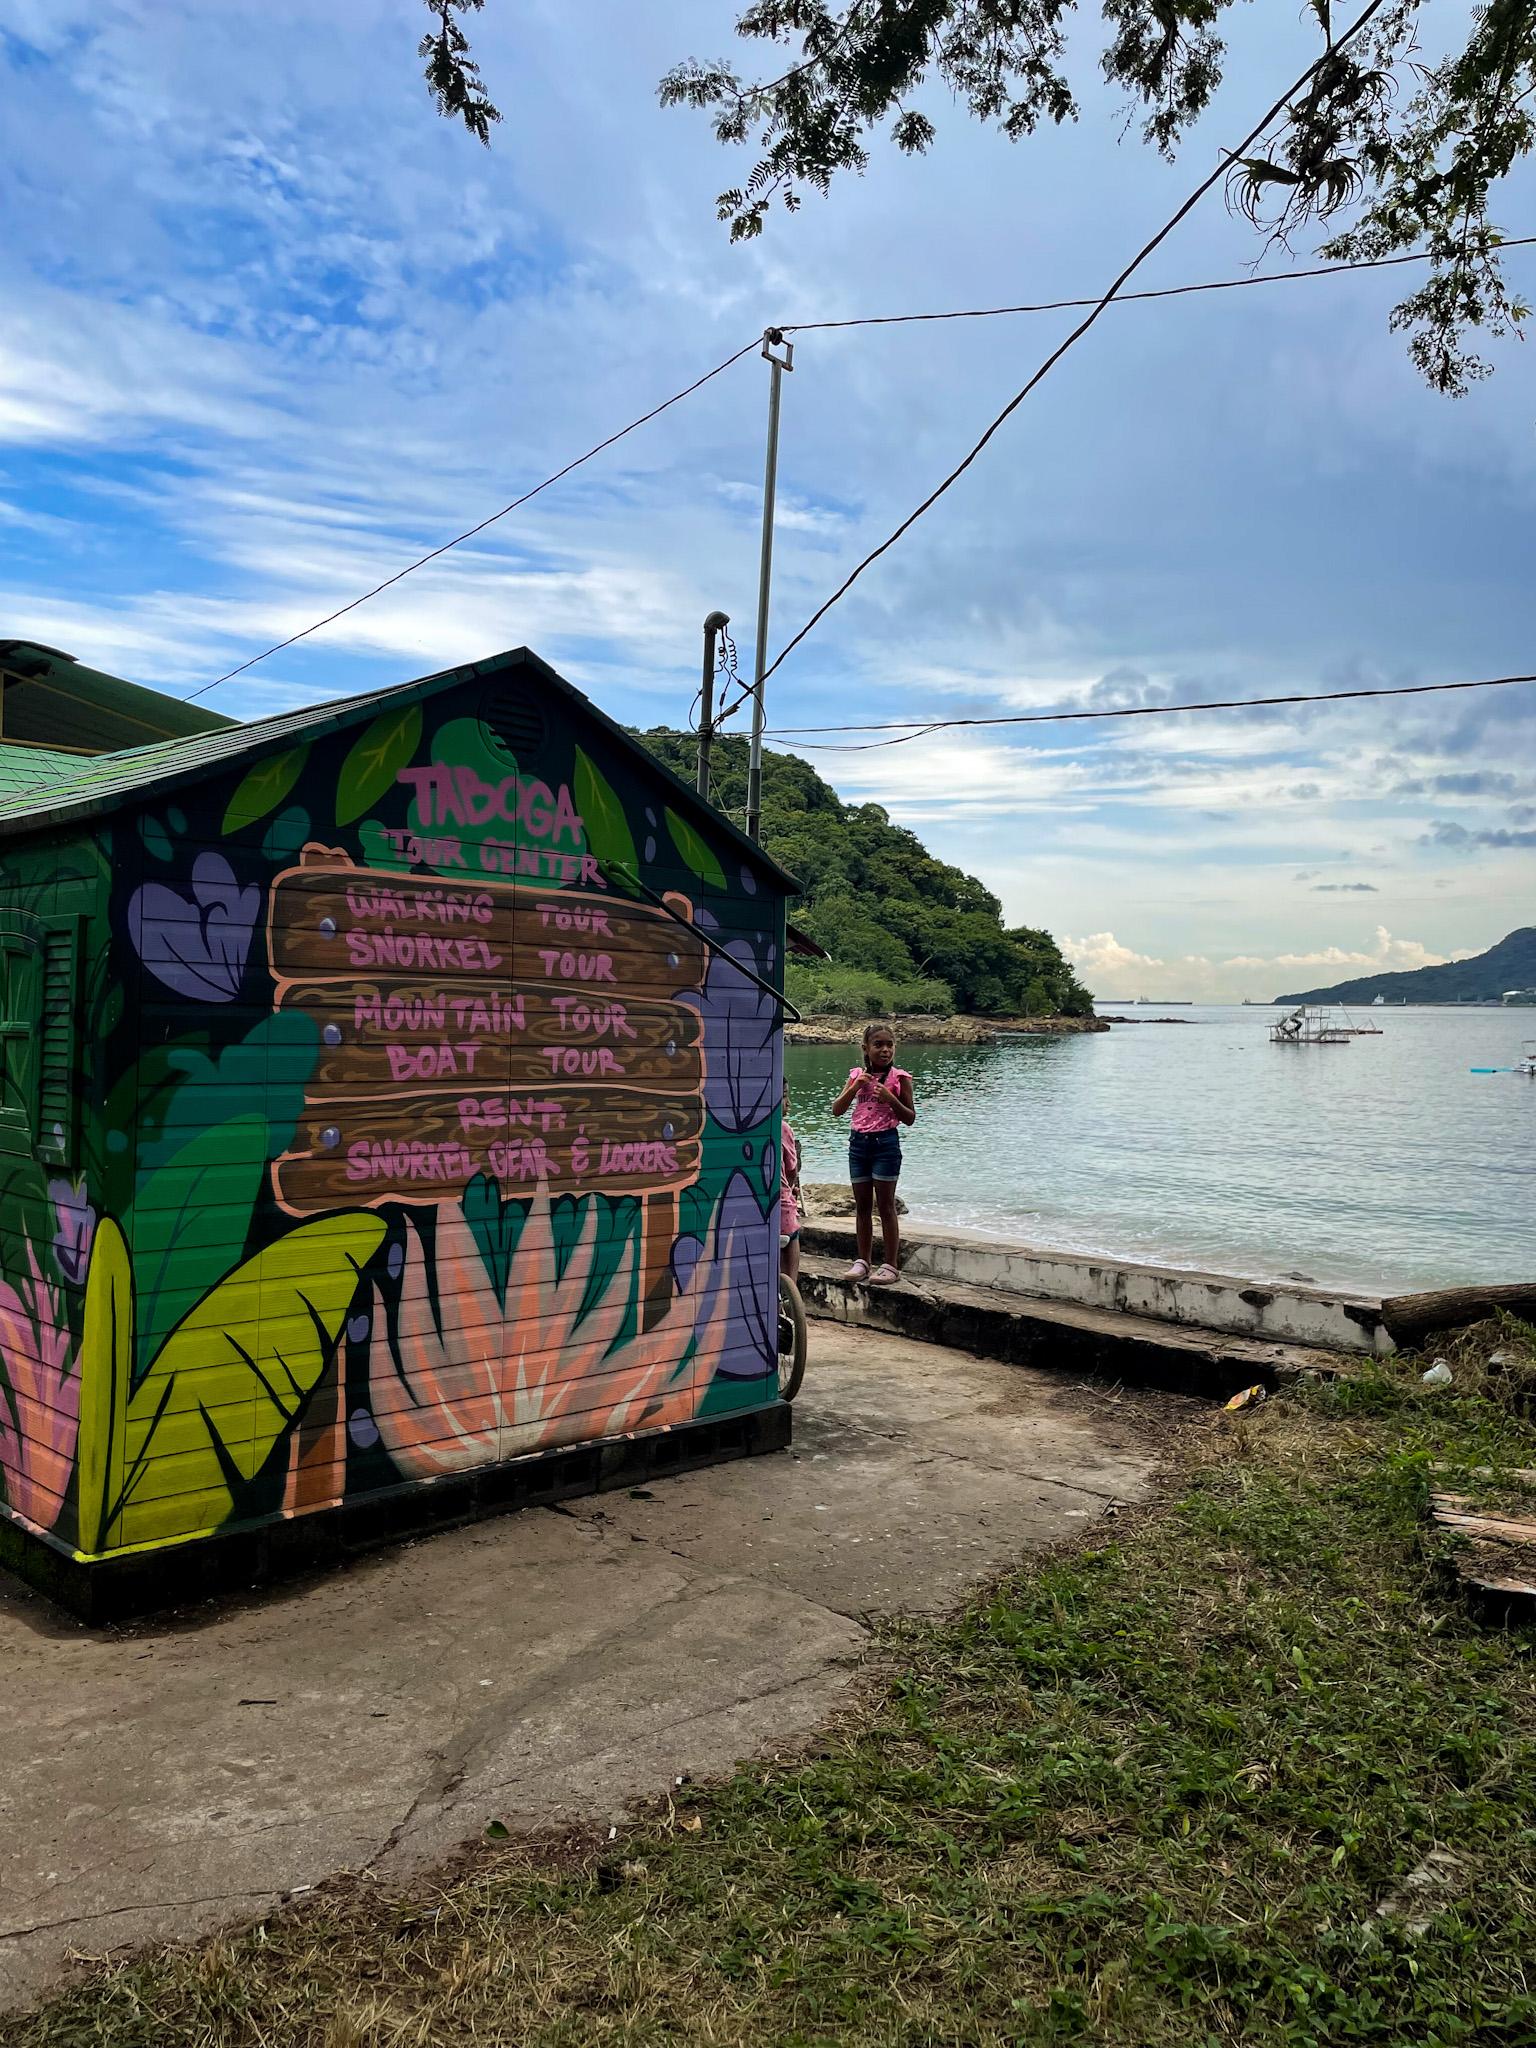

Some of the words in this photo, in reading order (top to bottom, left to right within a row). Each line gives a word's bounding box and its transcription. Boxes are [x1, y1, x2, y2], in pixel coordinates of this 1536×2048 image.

[380, 828, 468, 869] TOUR
[480, 836, 607, 889] CENTER
[535, 903, 614, 938] TOUR
[346, 926, 503, 970] SNORKEL
[538, 950, 618, 984] TOUR
[552, 995, 637, 1039] TOUR
[386, 1039, 482, 1081] BOAT
[542, 1046, 625, 1074] TOUR
[346, 1139, 482, 1181] SNORKEL
[489, 1138, 561, 1181] GEAR
[599, 1138, 679, 1177] LOCKERS
